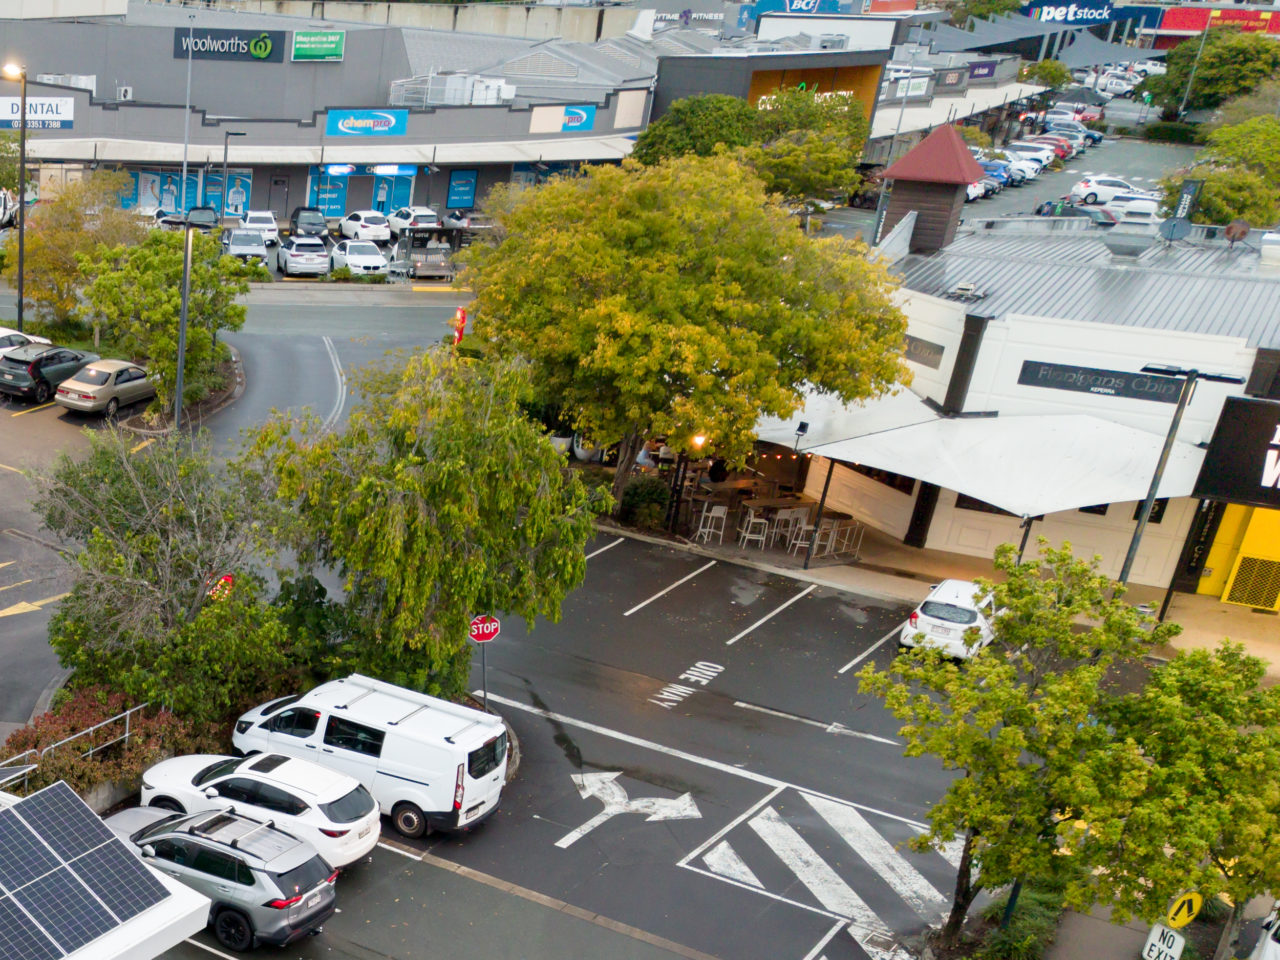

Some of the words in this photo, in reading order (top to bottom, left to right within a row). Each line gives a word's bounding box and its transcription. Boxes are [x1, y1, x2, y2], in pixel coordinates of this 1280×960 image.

[791, 0, 815, 10] BCF
[1041, 3, 1111, 22] petstock
[11, 102, 62, 115] DNTAL
[471, 622, 498, 635] STOP
[678, 661, 726, 686] ONE
[1158, 928, 1176, 949] NO
